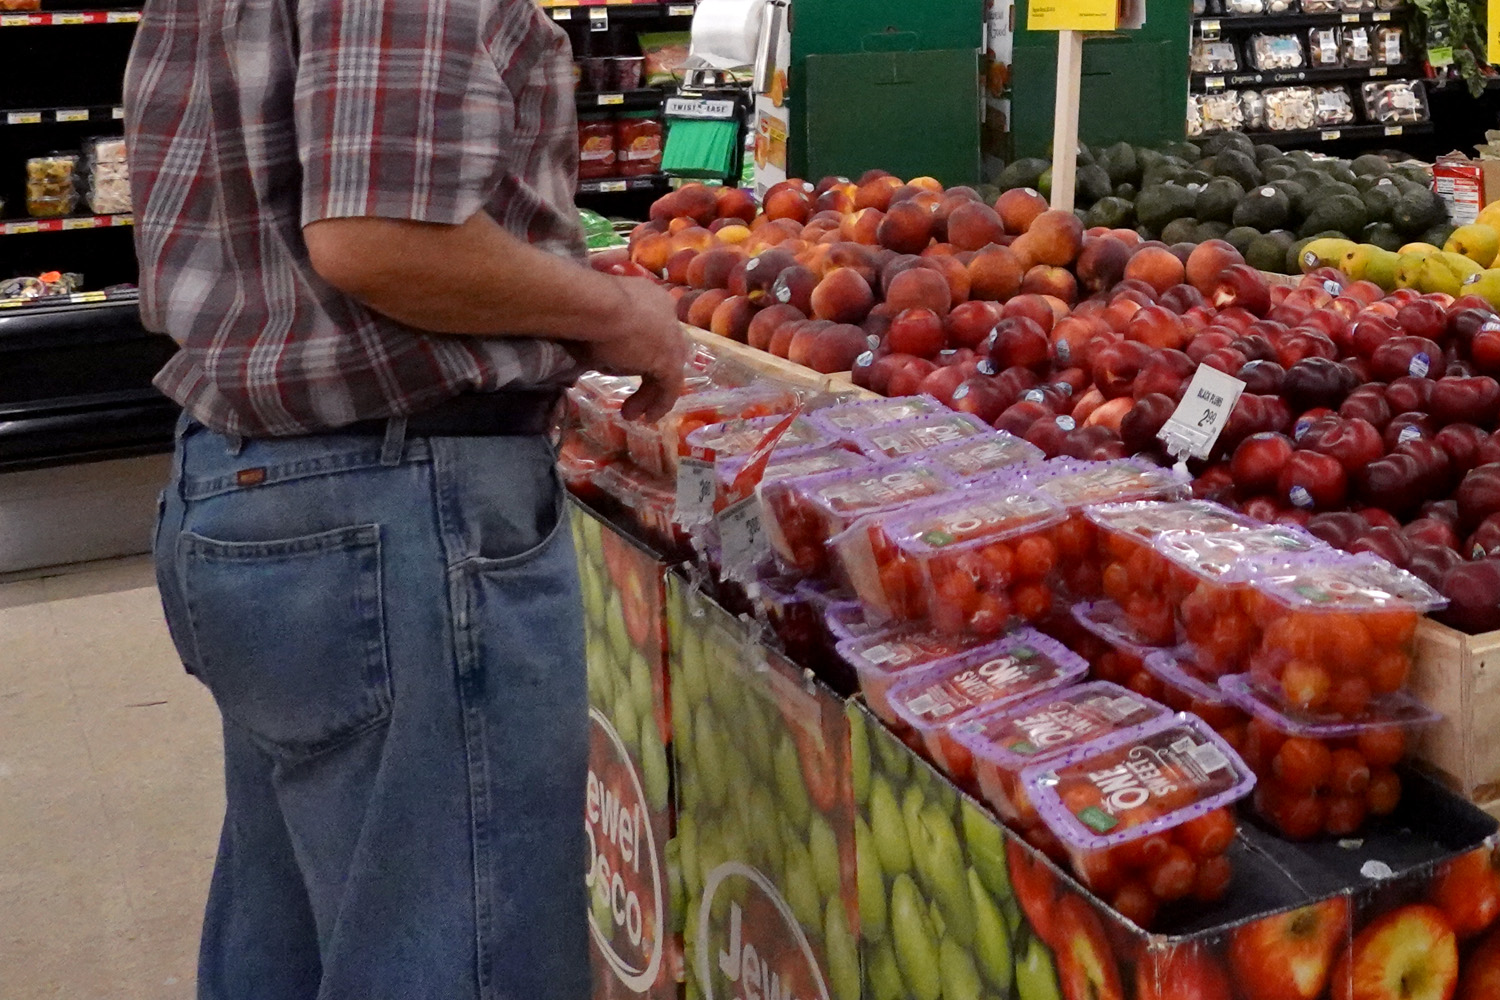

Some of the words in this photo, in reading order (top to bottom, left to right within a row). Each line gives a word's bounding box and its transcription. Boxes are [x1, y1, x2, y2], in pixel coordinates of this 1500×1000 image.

[673, 103, 697, 113] TWIST
[1196, 387, 1212, 403] BLACK
[1088, 764, 1150, 810] ONE
[1125, 757, 1179, 797] SWEET
